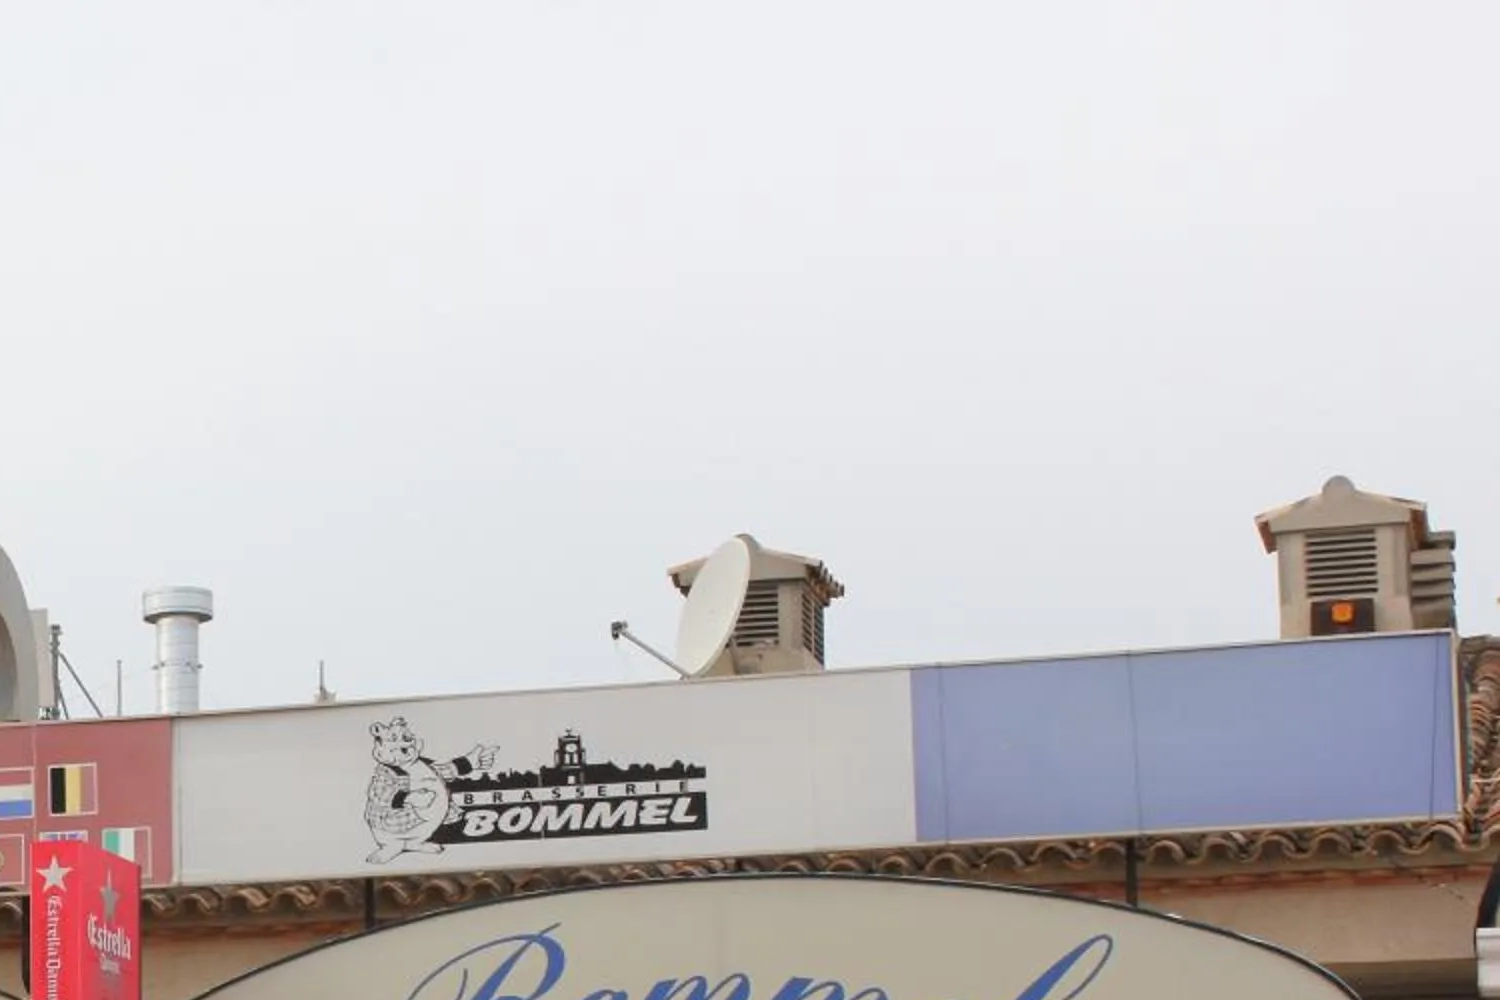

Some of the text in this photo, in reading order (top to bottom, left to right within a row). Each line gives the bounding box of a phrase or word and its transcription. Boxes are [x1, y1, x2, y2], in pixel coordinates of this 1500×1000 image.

[462, 797, 699, 837] BOMMEL
[47, 896, 62, 956] Estrella
[87, 912, 132, 961] Estrella
